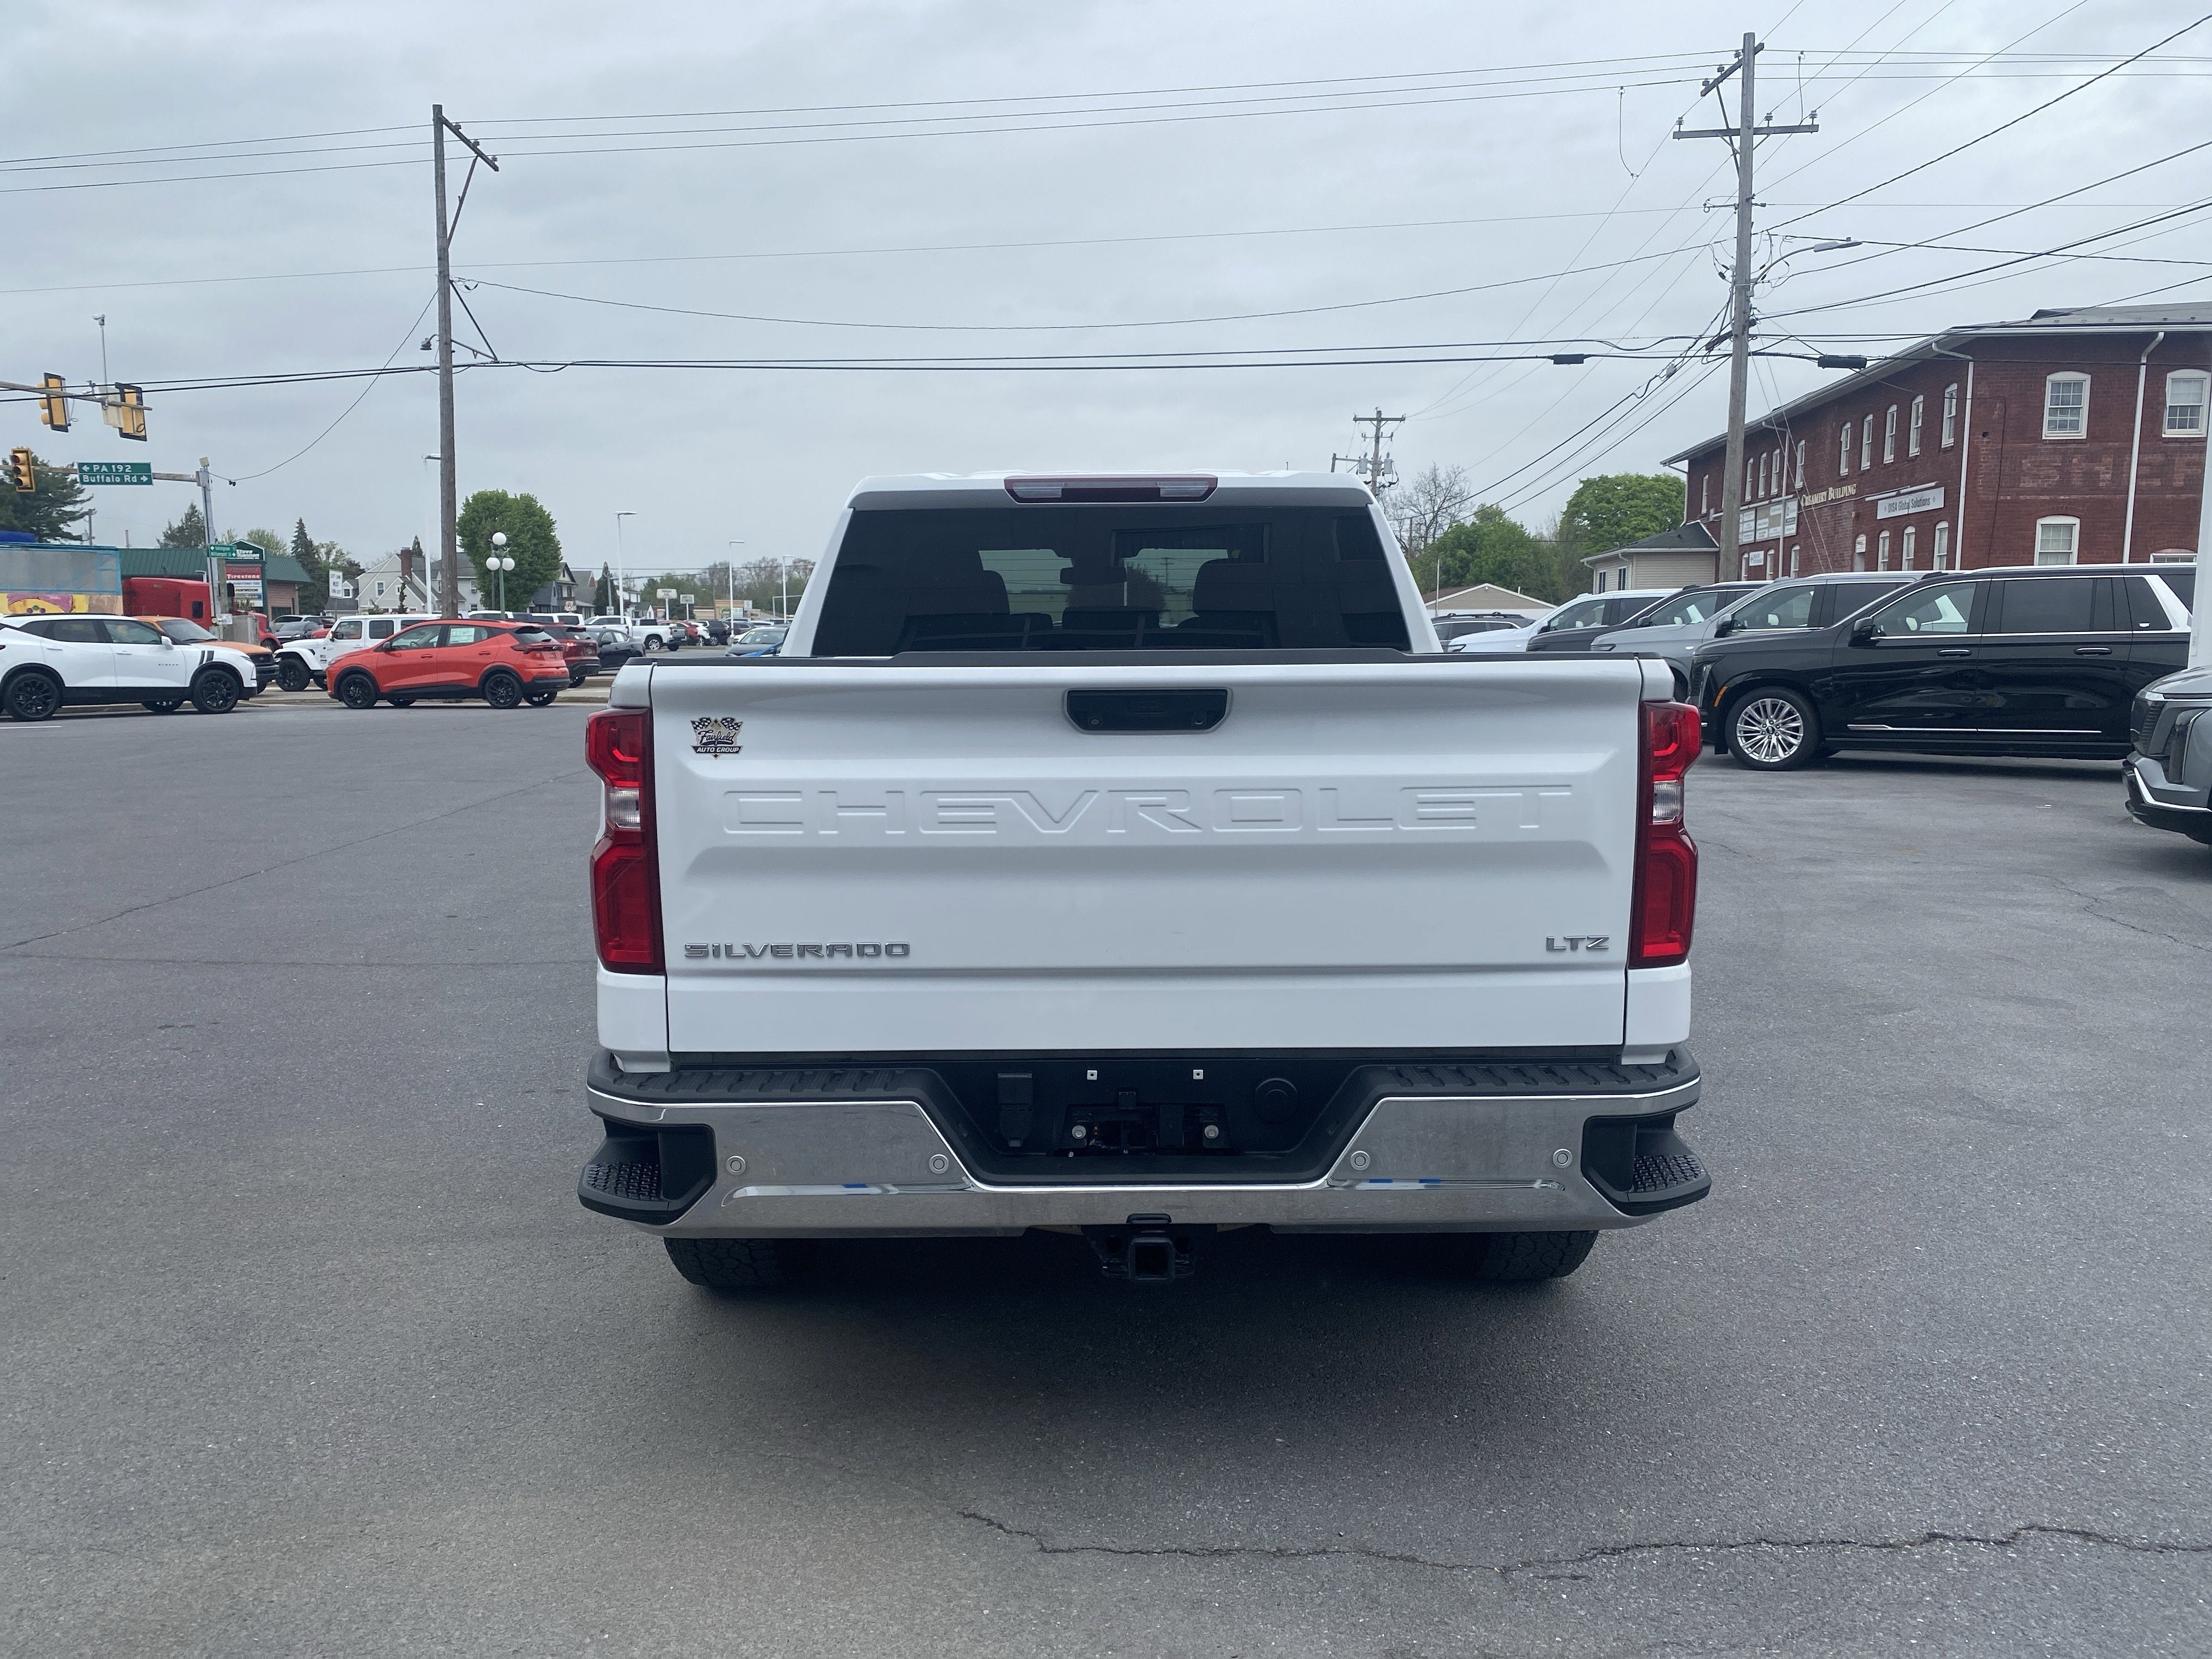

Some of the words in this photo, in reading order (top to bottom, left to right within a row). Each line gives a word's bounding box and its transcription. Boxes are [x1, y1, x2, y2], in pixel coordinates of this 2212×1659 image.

[1898, 498, 1910, 511] Global
[1911, 496, 1931, 509] Solutions
[697, 730, 737, 744] Fairfield
[724, 784, 1572, 834] CHEVROLET
[684, 942, 910, 958] SILVERADO
[1546, 935, 1610, 951] LTZ
